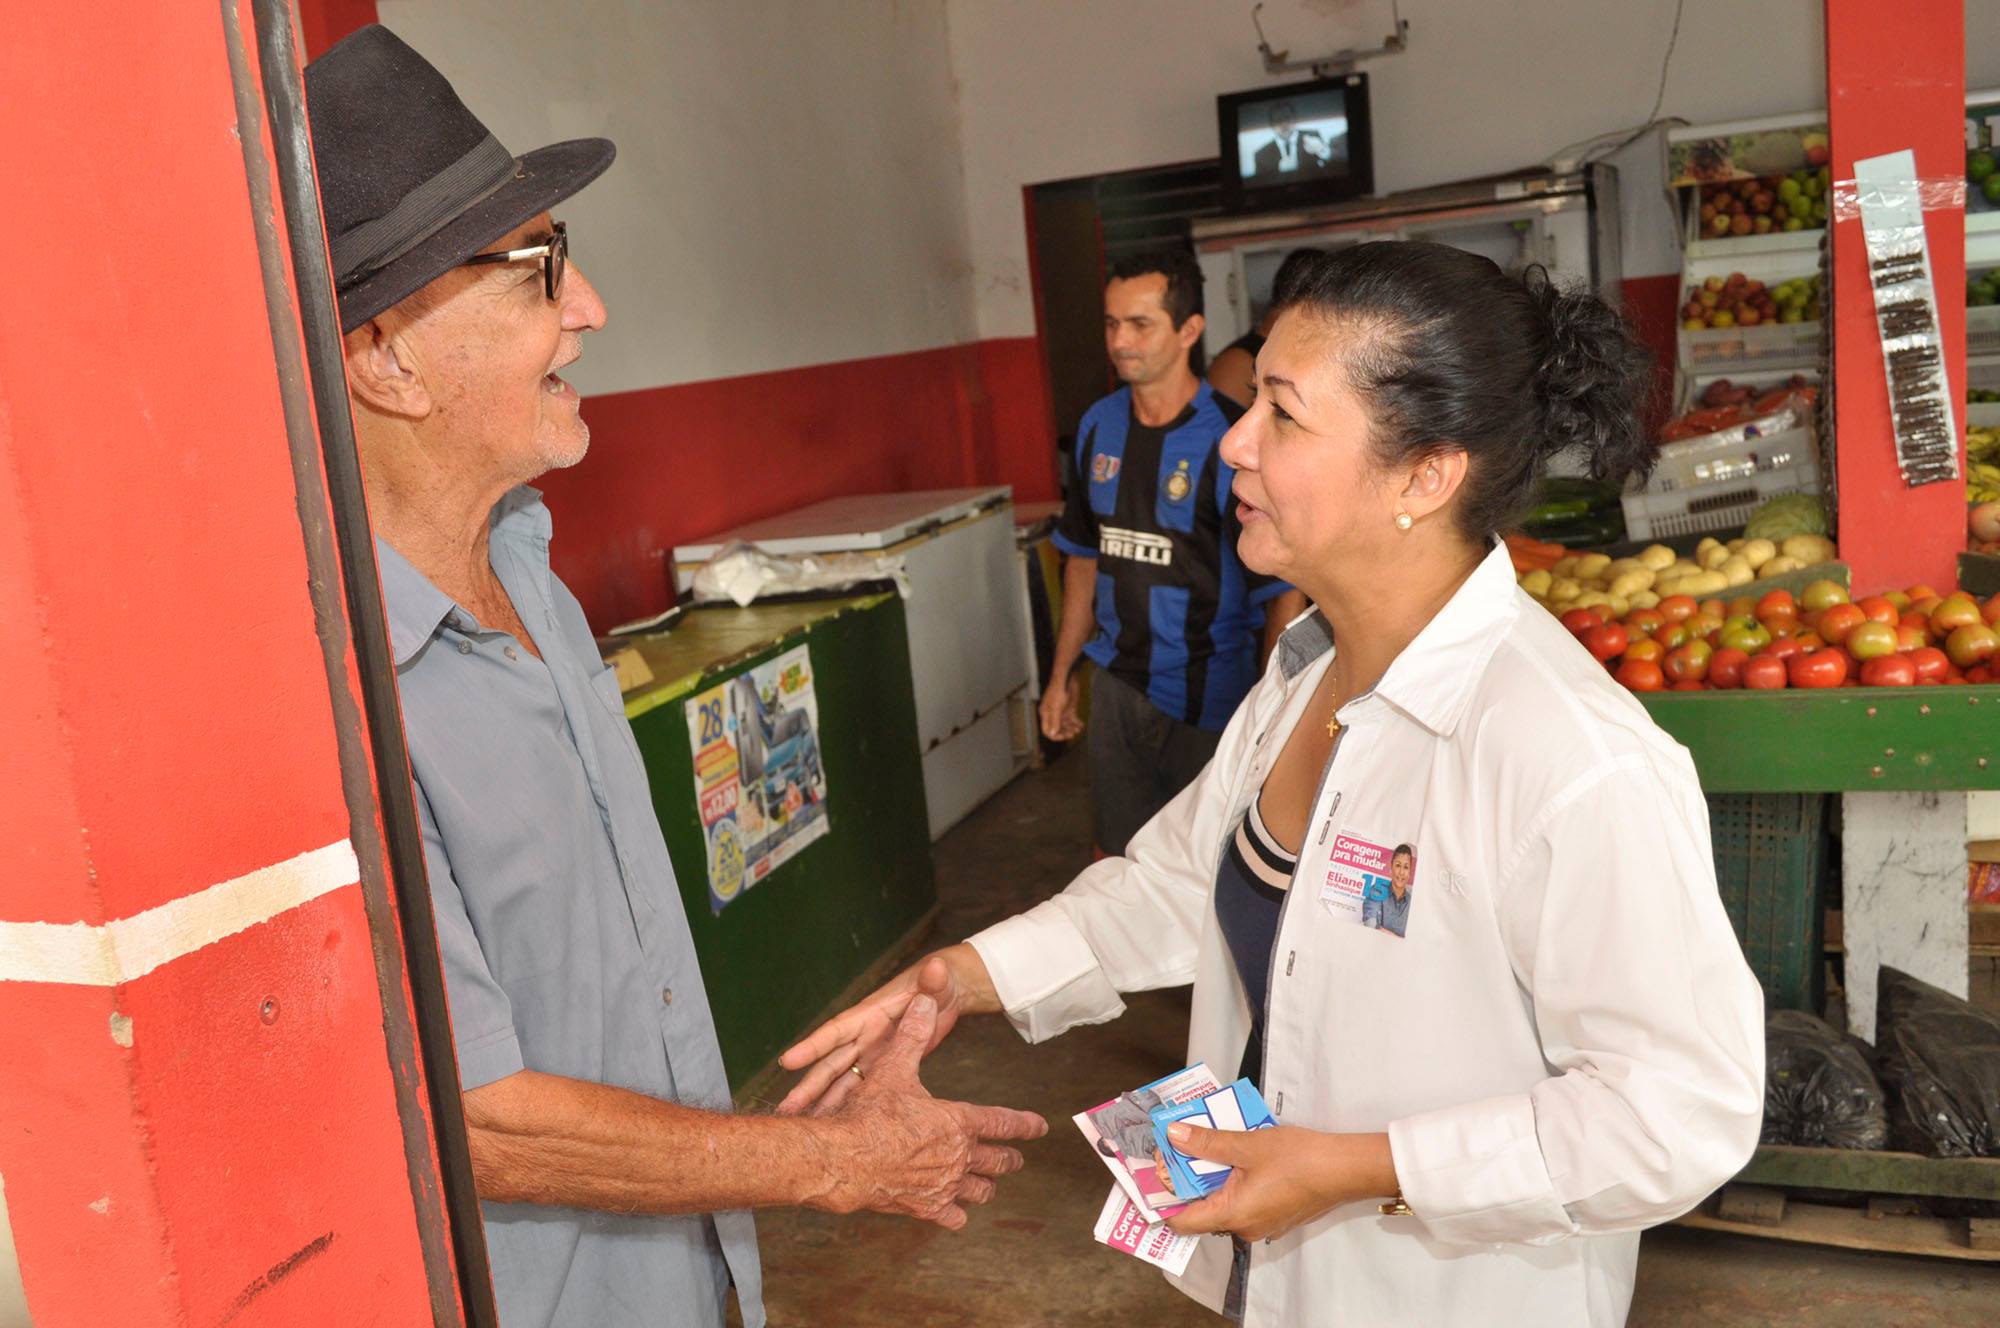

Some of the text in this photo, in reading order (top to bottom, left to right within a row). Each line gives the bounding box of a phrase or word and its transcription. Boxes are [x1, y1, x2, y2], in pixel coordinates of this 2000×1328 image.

[1099, 523, 1173, 566] PIRELLI
[699, 698, 723, 745] 28
[1332, 849, 1351, 861] pra
[1352, 854, 1387, 870] mudar
[1336, 838, 1382, 858] Coragem
[1327, 871, 1364, 889] Eliane
[1362, 873, 1392, 902] 15
[1113, 1204, 1139, 1241] Corag
[1124, 1224, 1142, 1248] pra
[1147, 1224, 1170, 1258] Elian
